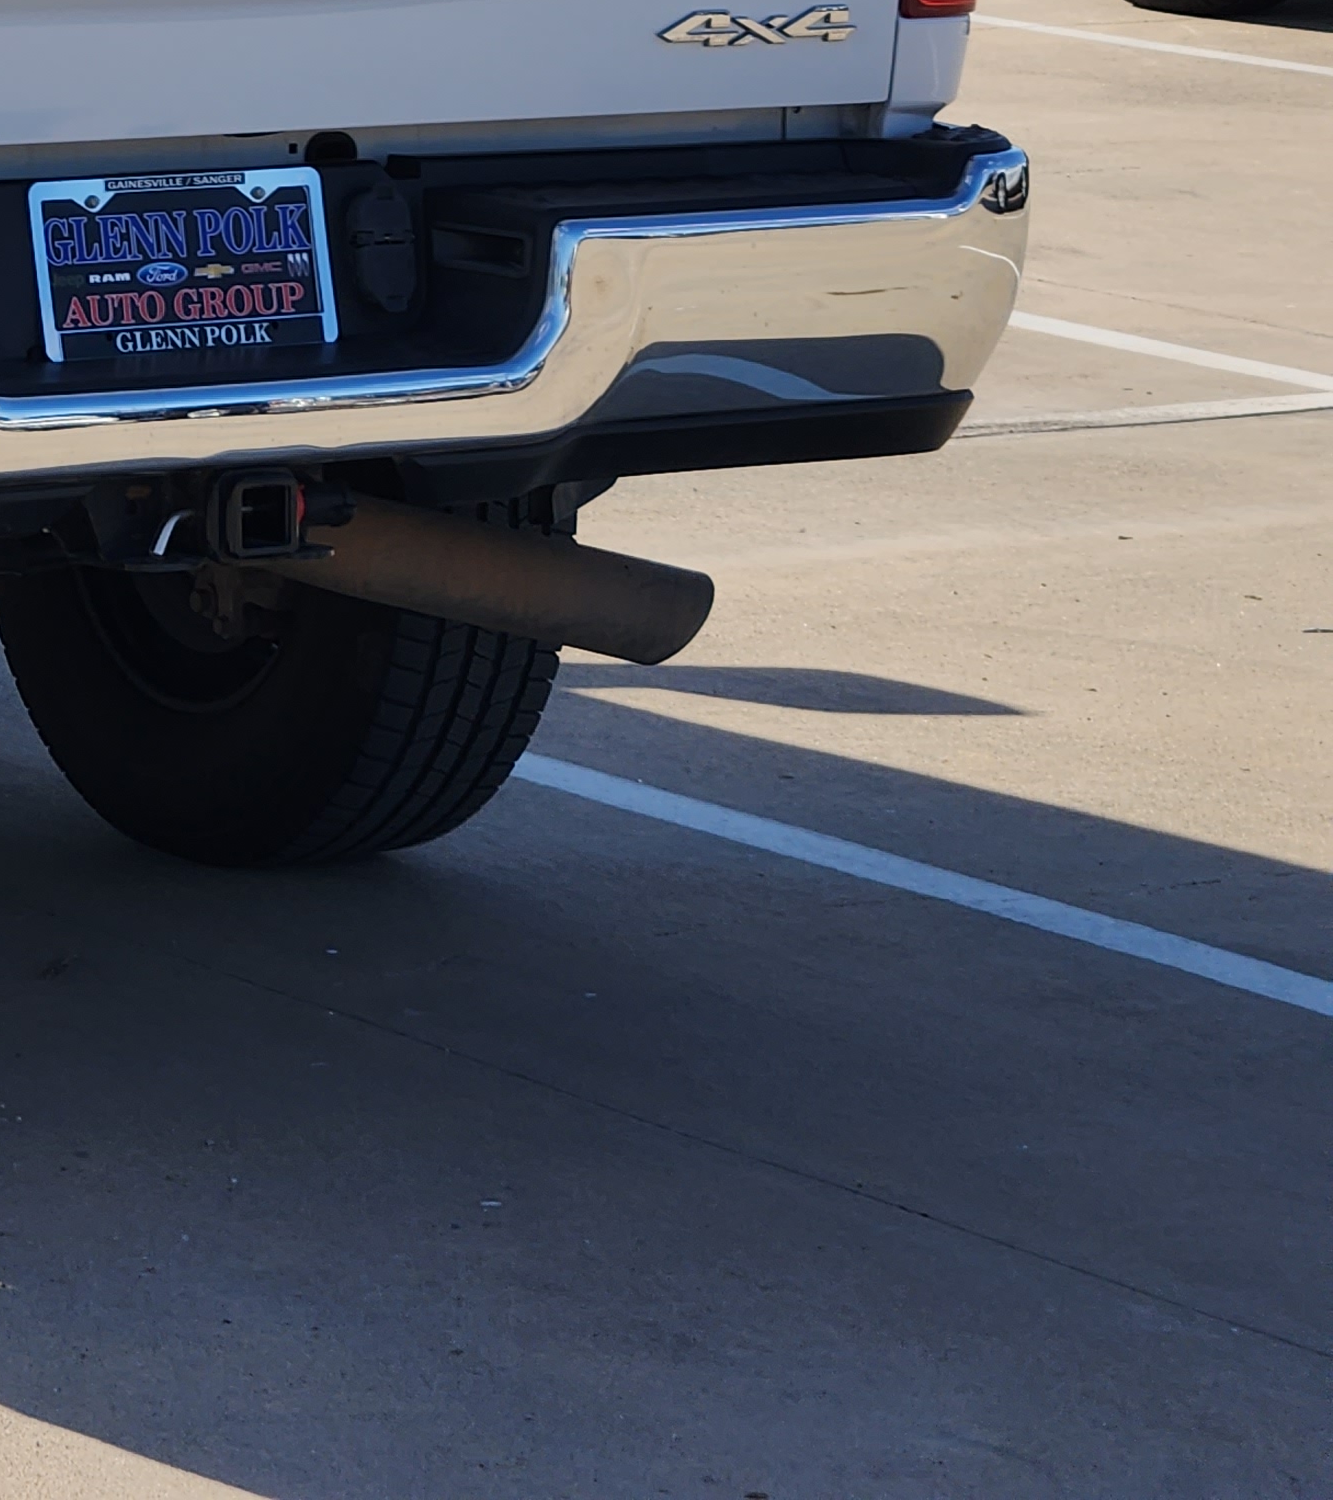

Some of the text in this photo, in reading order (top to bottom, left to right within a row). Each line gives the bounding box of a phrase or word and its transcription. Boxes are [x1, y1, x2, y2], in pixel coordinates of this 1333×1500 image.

[107, 177, 184, 190] GAINESVILLE
[193, 174, 242, 186] SANGER
[44, 203, 312, 266] GLENN POLK
[89, 272, 131, 283] RAM
[146, 265, 178, 282] Ford
[241, 262, 282, 272] GMC
[63, 281, 305, 329] AUTO GROUP
[116, 322, 272, 353] GLENN POLK
